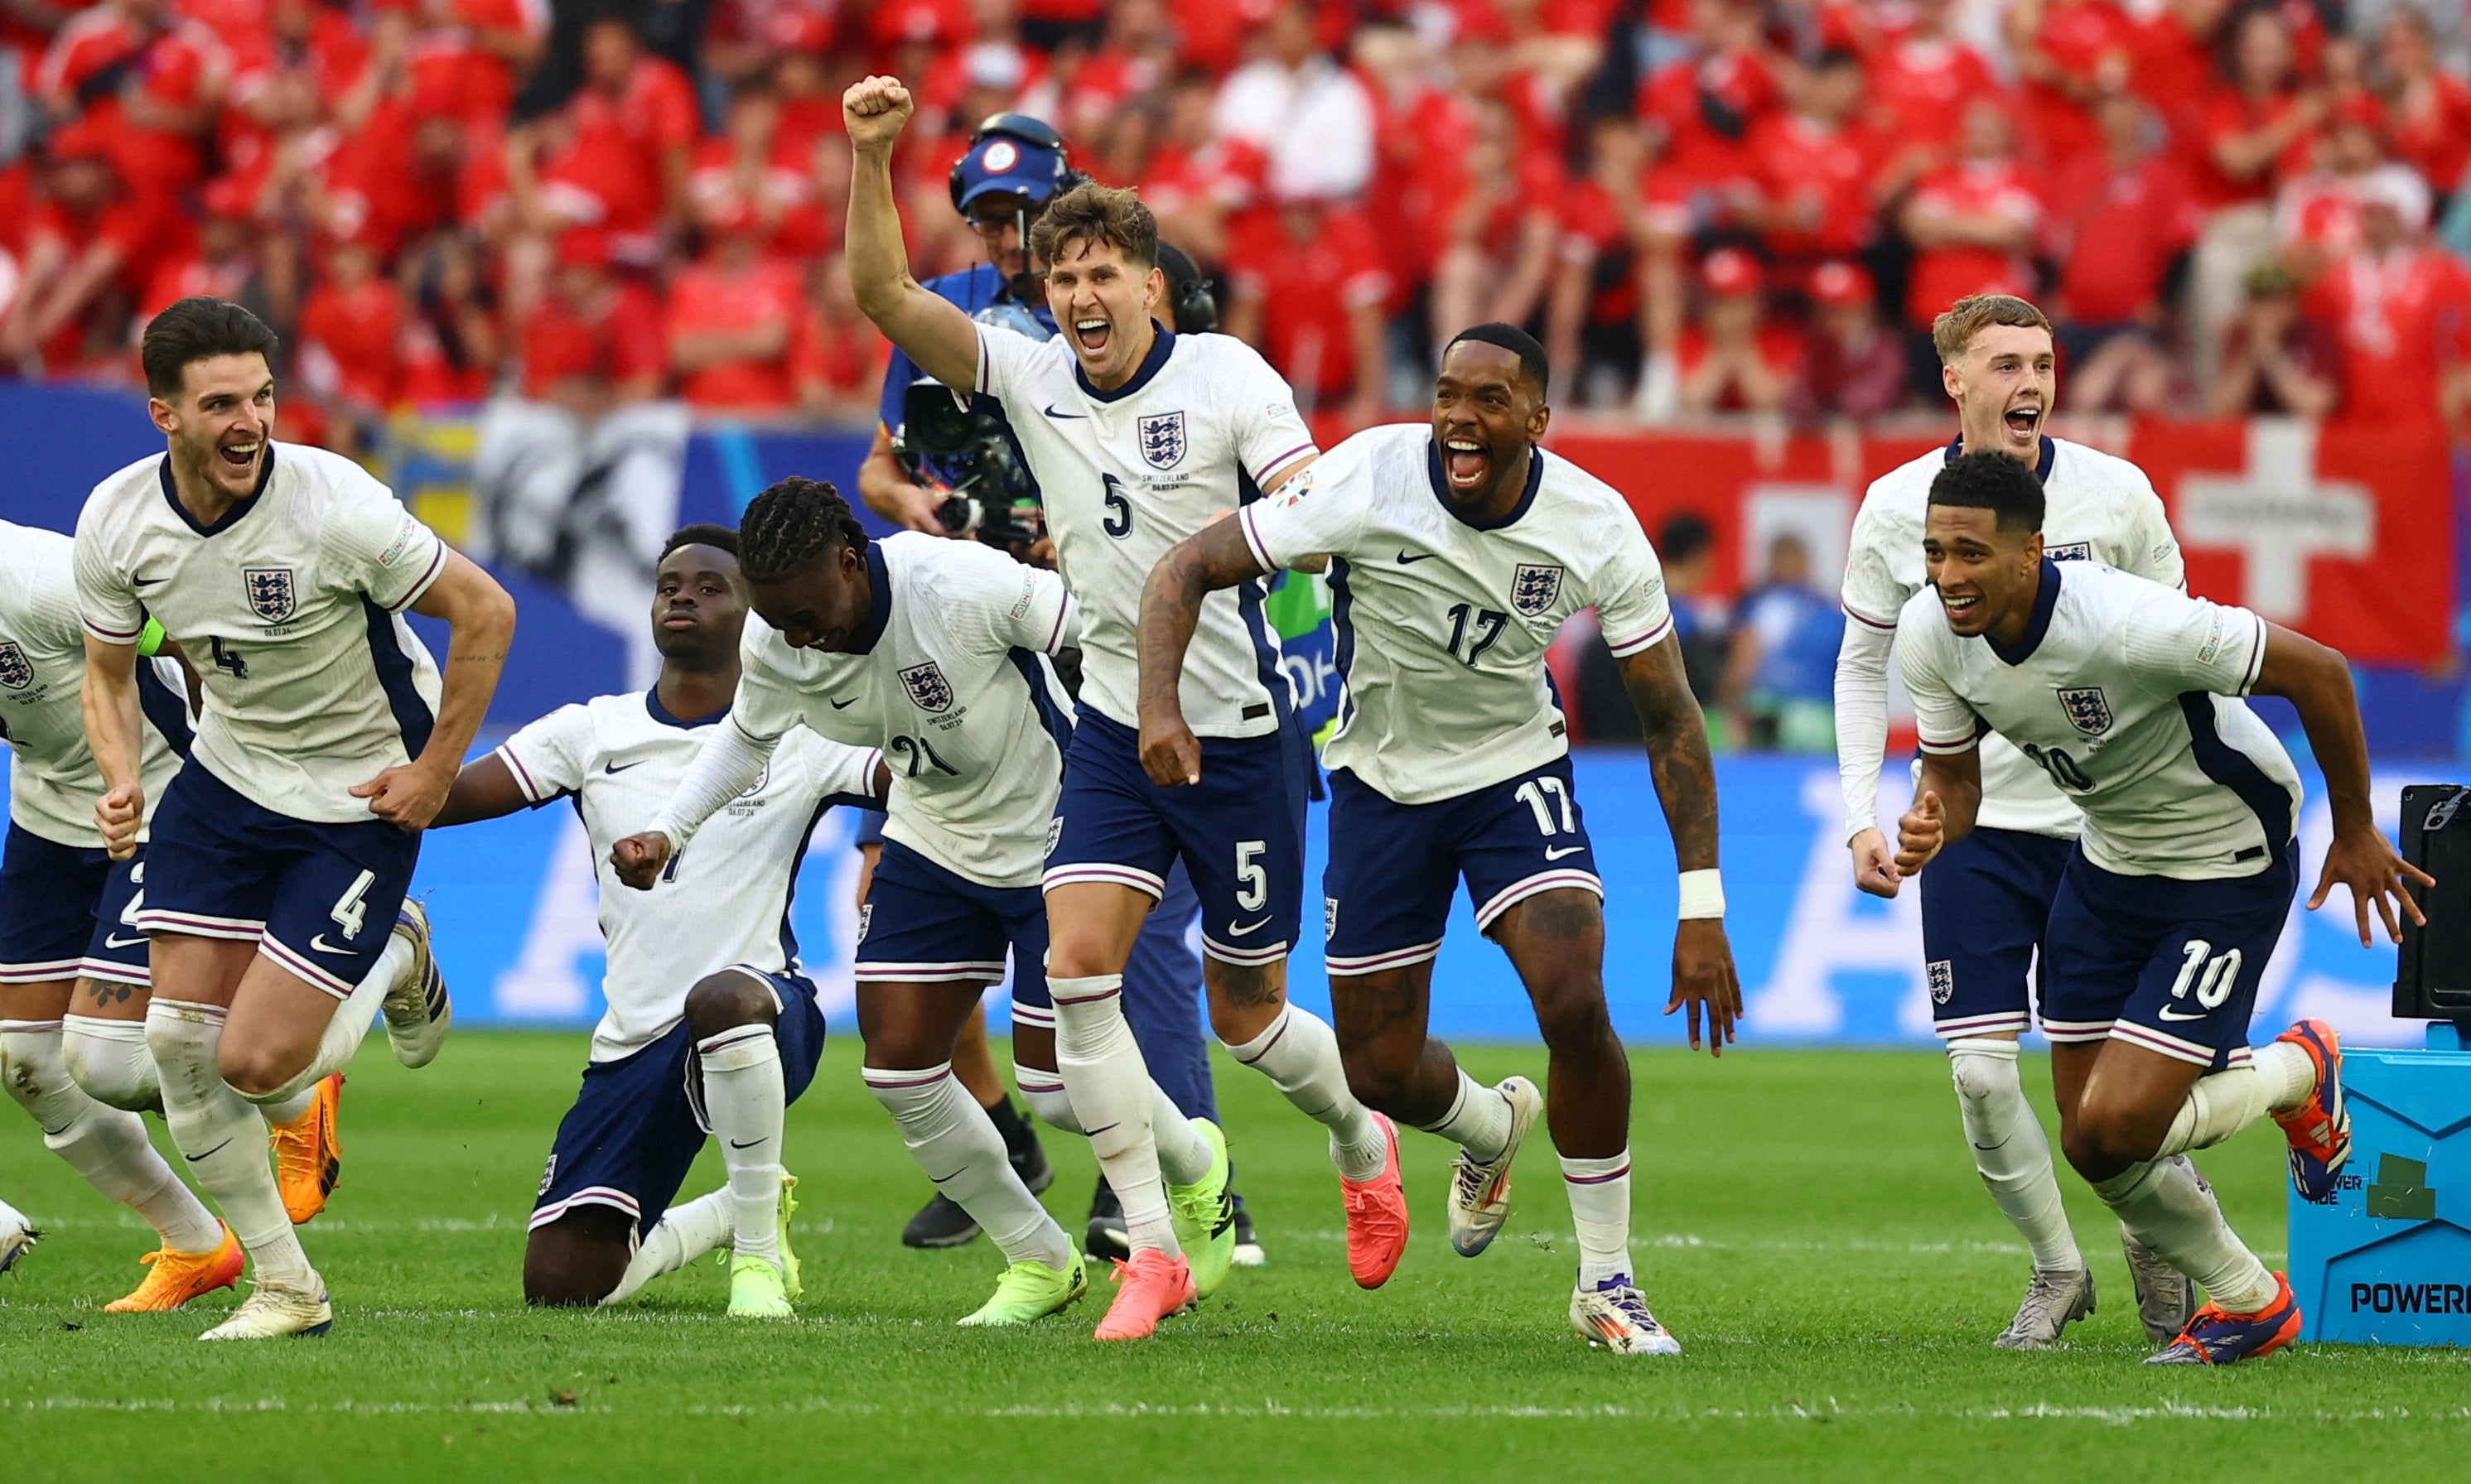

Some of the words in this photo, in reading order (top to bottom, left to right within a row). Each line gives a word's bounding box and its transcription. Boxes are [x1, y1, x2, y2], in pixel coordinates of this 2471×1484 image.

[1103, 472, 1134, 540] 5
[1143, 473, 1190, 482] SWITZERLAND
[208, 634, 248, 679] 4
[1447, 603, 1511, 667] 17
[926, 706, 968, 725] SWITZERLAND
[1514, 776, 1576, 836] 17
[331, 868, 376, 941] 4
[1236, 840, 1267, 912] 5
[2171, 938, 2242, 1010] 10
